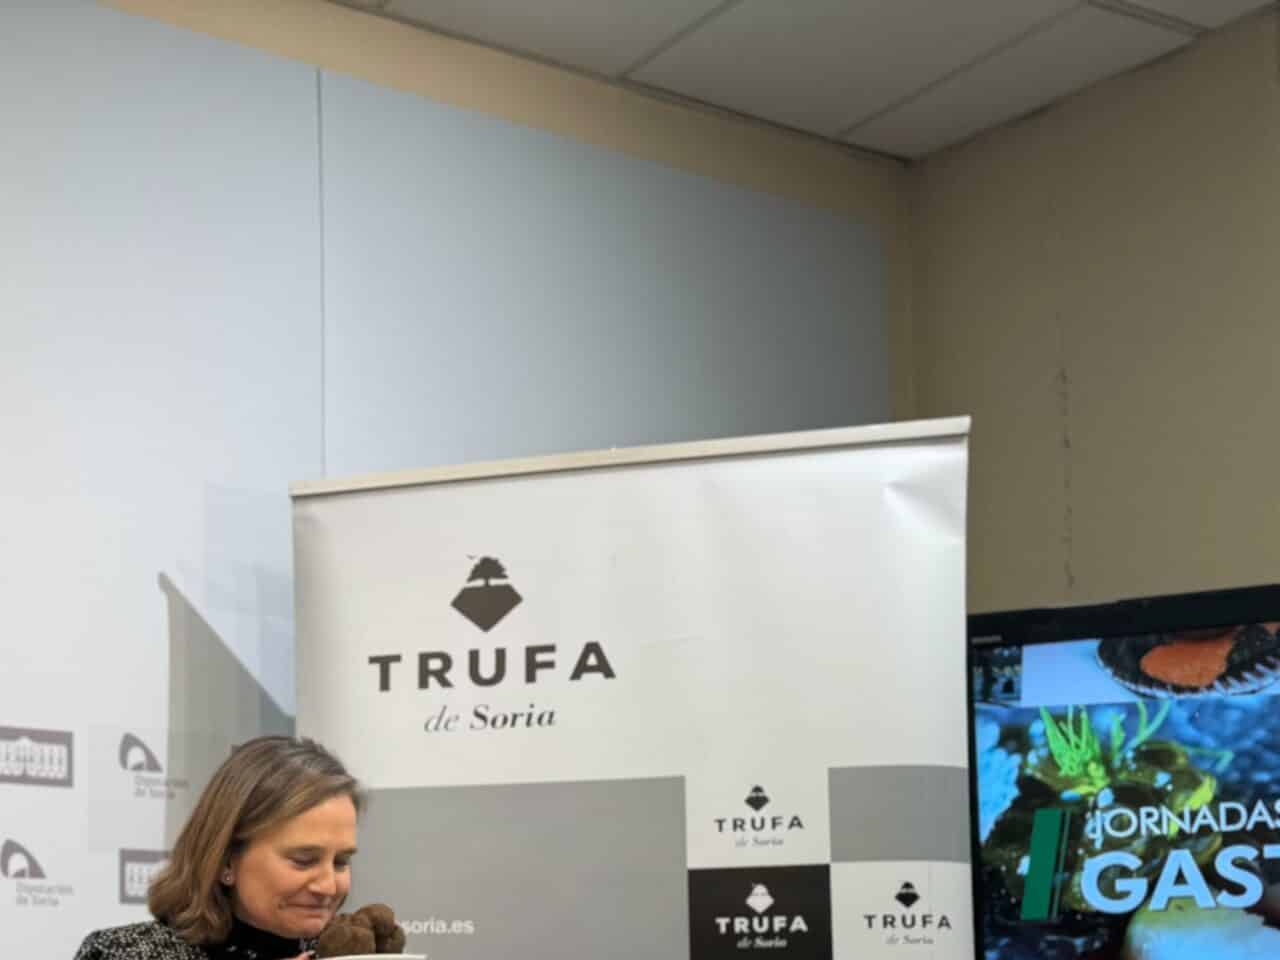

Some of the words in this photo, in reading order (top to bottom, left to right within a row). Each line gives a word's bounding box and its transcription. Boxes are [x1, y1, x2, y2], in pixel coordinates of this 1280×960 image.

[368, 641, 616, 692] TRUFA
[424, 704, 460, 733] de
[470, 702, 556, 731] Soria
[714, 815, 805, 833] TRUFA
[398, 917, 475, 935] soria.es
[715, 915, 809, 934] TRUFA
[864, 914, 952, 930] TRUFA
